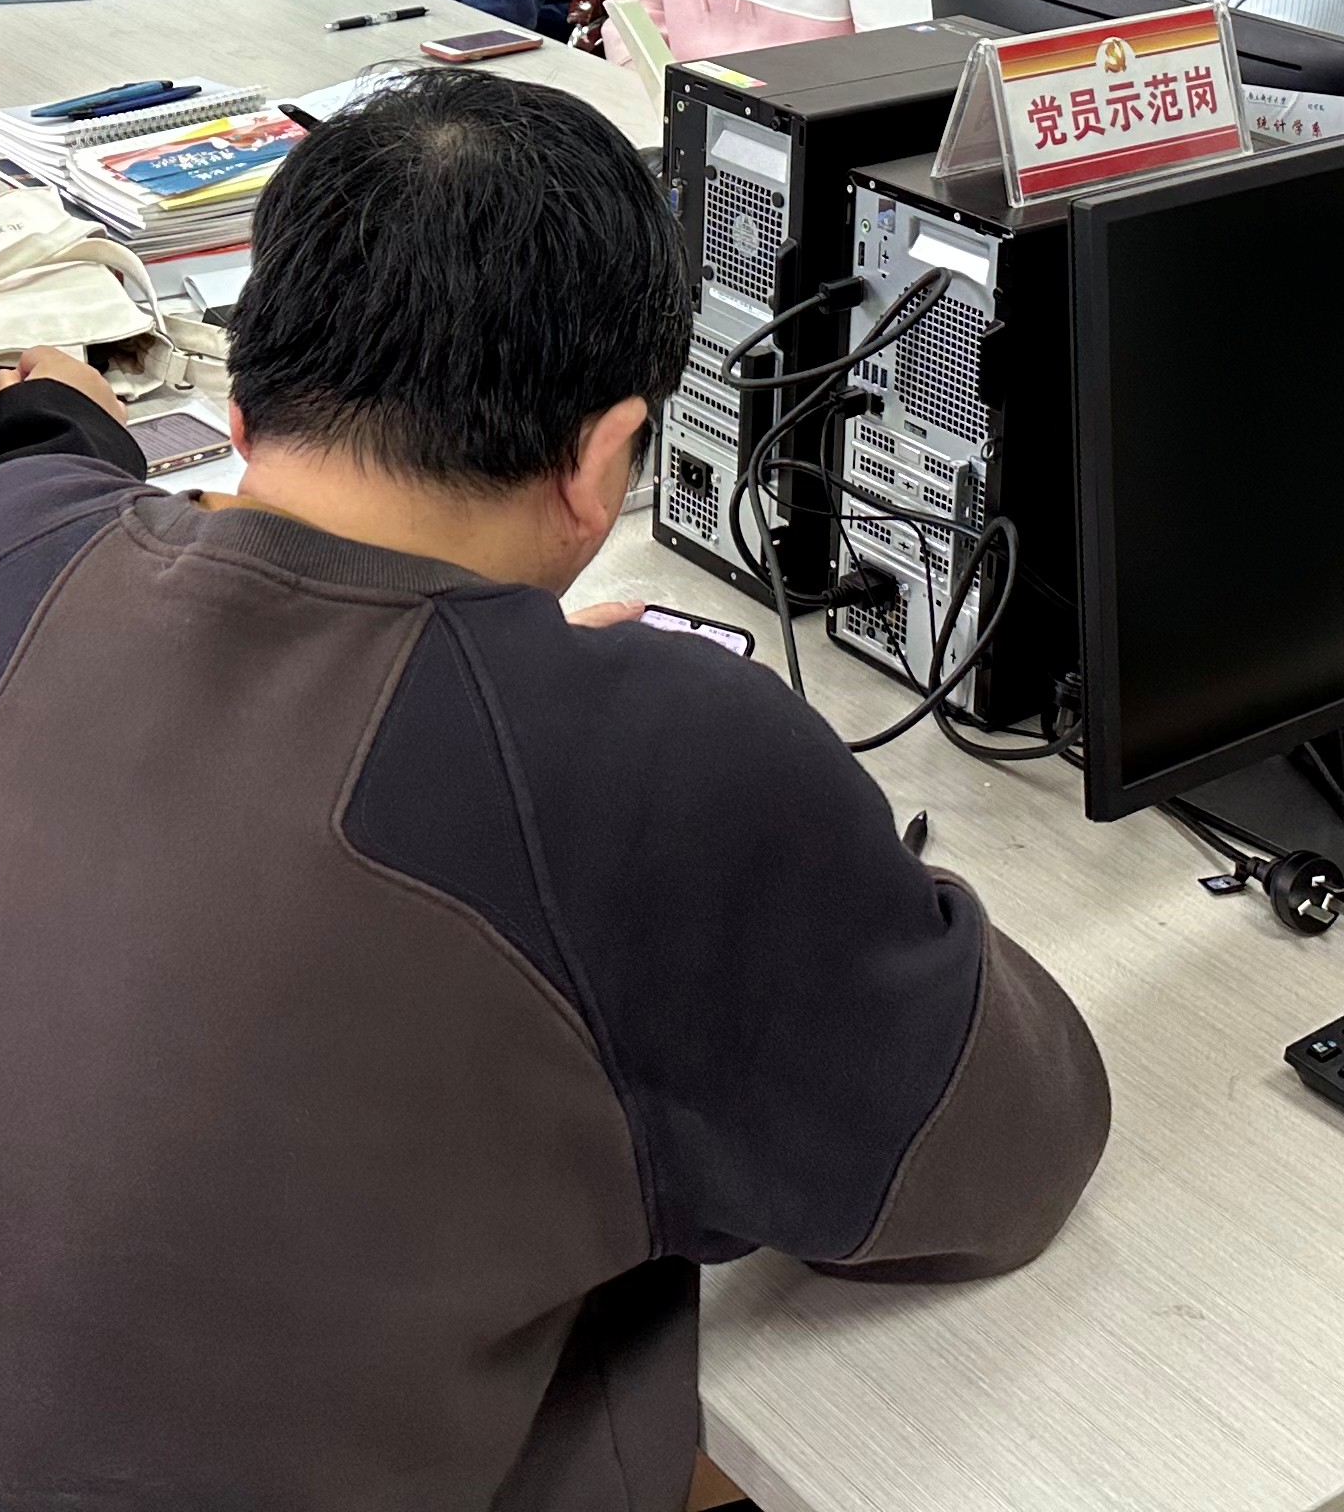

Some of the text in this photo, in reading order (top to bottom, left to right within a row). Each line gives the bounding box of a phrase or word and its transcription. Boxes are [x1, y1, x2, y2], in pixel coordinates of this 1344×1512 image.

[1027, 66, 1218, 150] 党员示范岗
